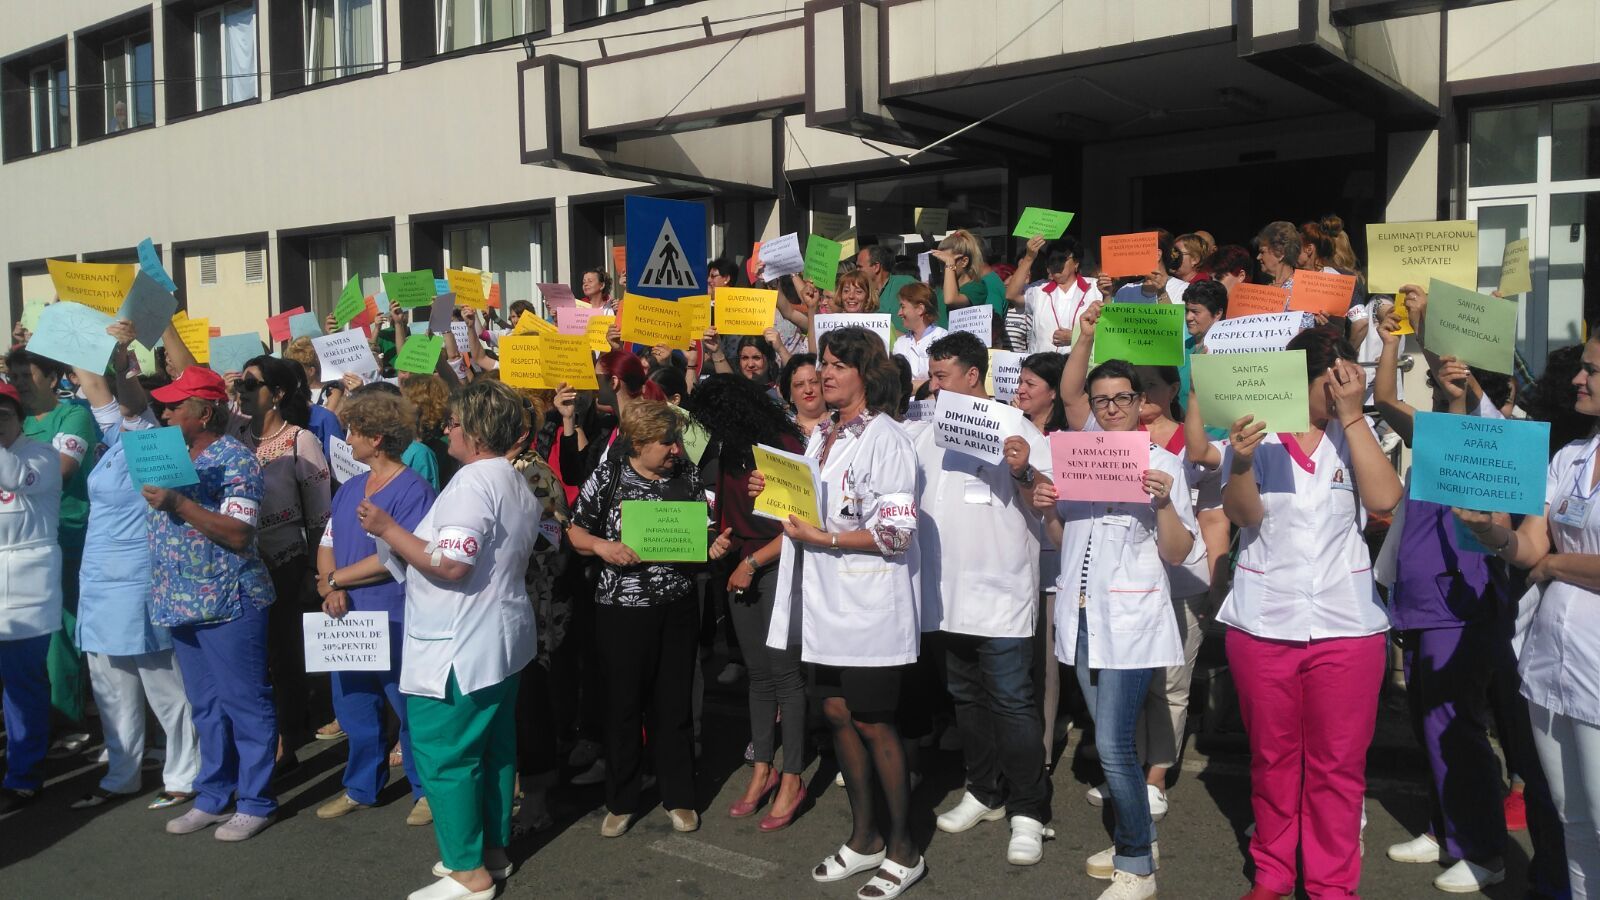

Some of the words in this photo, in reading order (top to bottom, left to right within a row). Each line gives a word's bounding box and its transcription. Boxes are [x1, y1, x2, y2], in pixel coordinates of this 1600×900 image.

[1378, 232, 1423, 241] ELIMINAȚI
[1426, 230, 1476, 239] PLAFONUL
[1393, 245, 1405, 253] DE
[1401, 257, 1451, 266] SĂNĂTATE!
[65, 271, 120, 284] GUVERNANȚI,
[1105, 306, 1136, 314] RAPORT
[1138, 307, 1177, 316] SALARIAL
[1456, 299, 1485, 313] SANITAS
[818, 320, 844, 329] LEGEA
[1124, 317, 1158, 325] RUȘINOS
[1105, 327, 1178, 337] MEDIC-FARMACIST
[1210, 327, 1292, 341] RESPECTAȚI-VĂ
[1440, 319, 1460, 333] ECHIPA
[1461, 327, 1500, 343] MEDICALĂ!
[1232, 365, 1269, 373] SANITAS
[1236, 379, 1266, 387] APĂRĂ
[1214, 393, 1243, 401] ECHIPA
[1244, 392, 1293, 401] MEDICALĂ!
[973, 402, 988, 412] NU
[945, 410, 1000, 430] DIMINUĂRII
[1461, 421, 1503, 433] SANITAS
[938, 422, 1000, 443] VENITURILOR
[944, 435, 960, 445] SAL
[964, 439, 999, 456] ARIALE!
[1463, 438, 1498, 450] APĂRĂ
[1072, 448, 1130, 457] FARMACIȘTII
[1068, 460, 1088, 468] SUNT
[1091, 461, 1119, 469] PARTE
[1444, 453, 1517, 470] INFIRMIERELE,
[1062, 472, 1093, 480] ECHIPA
[1439, 467, 1520, 486] BRANCARDIERII,
[766, 498, 786, 510] LEGEA
[880, 503, 910, 518] GREVĂ
[324, 619, 374, 628] ELIMINAȚI
[316, 631, 367, 639] PLAFONUL
[322, 642, 377, 651] 30%PENTRU
[324, 653, 377, 662] SĂNĂTATE!
